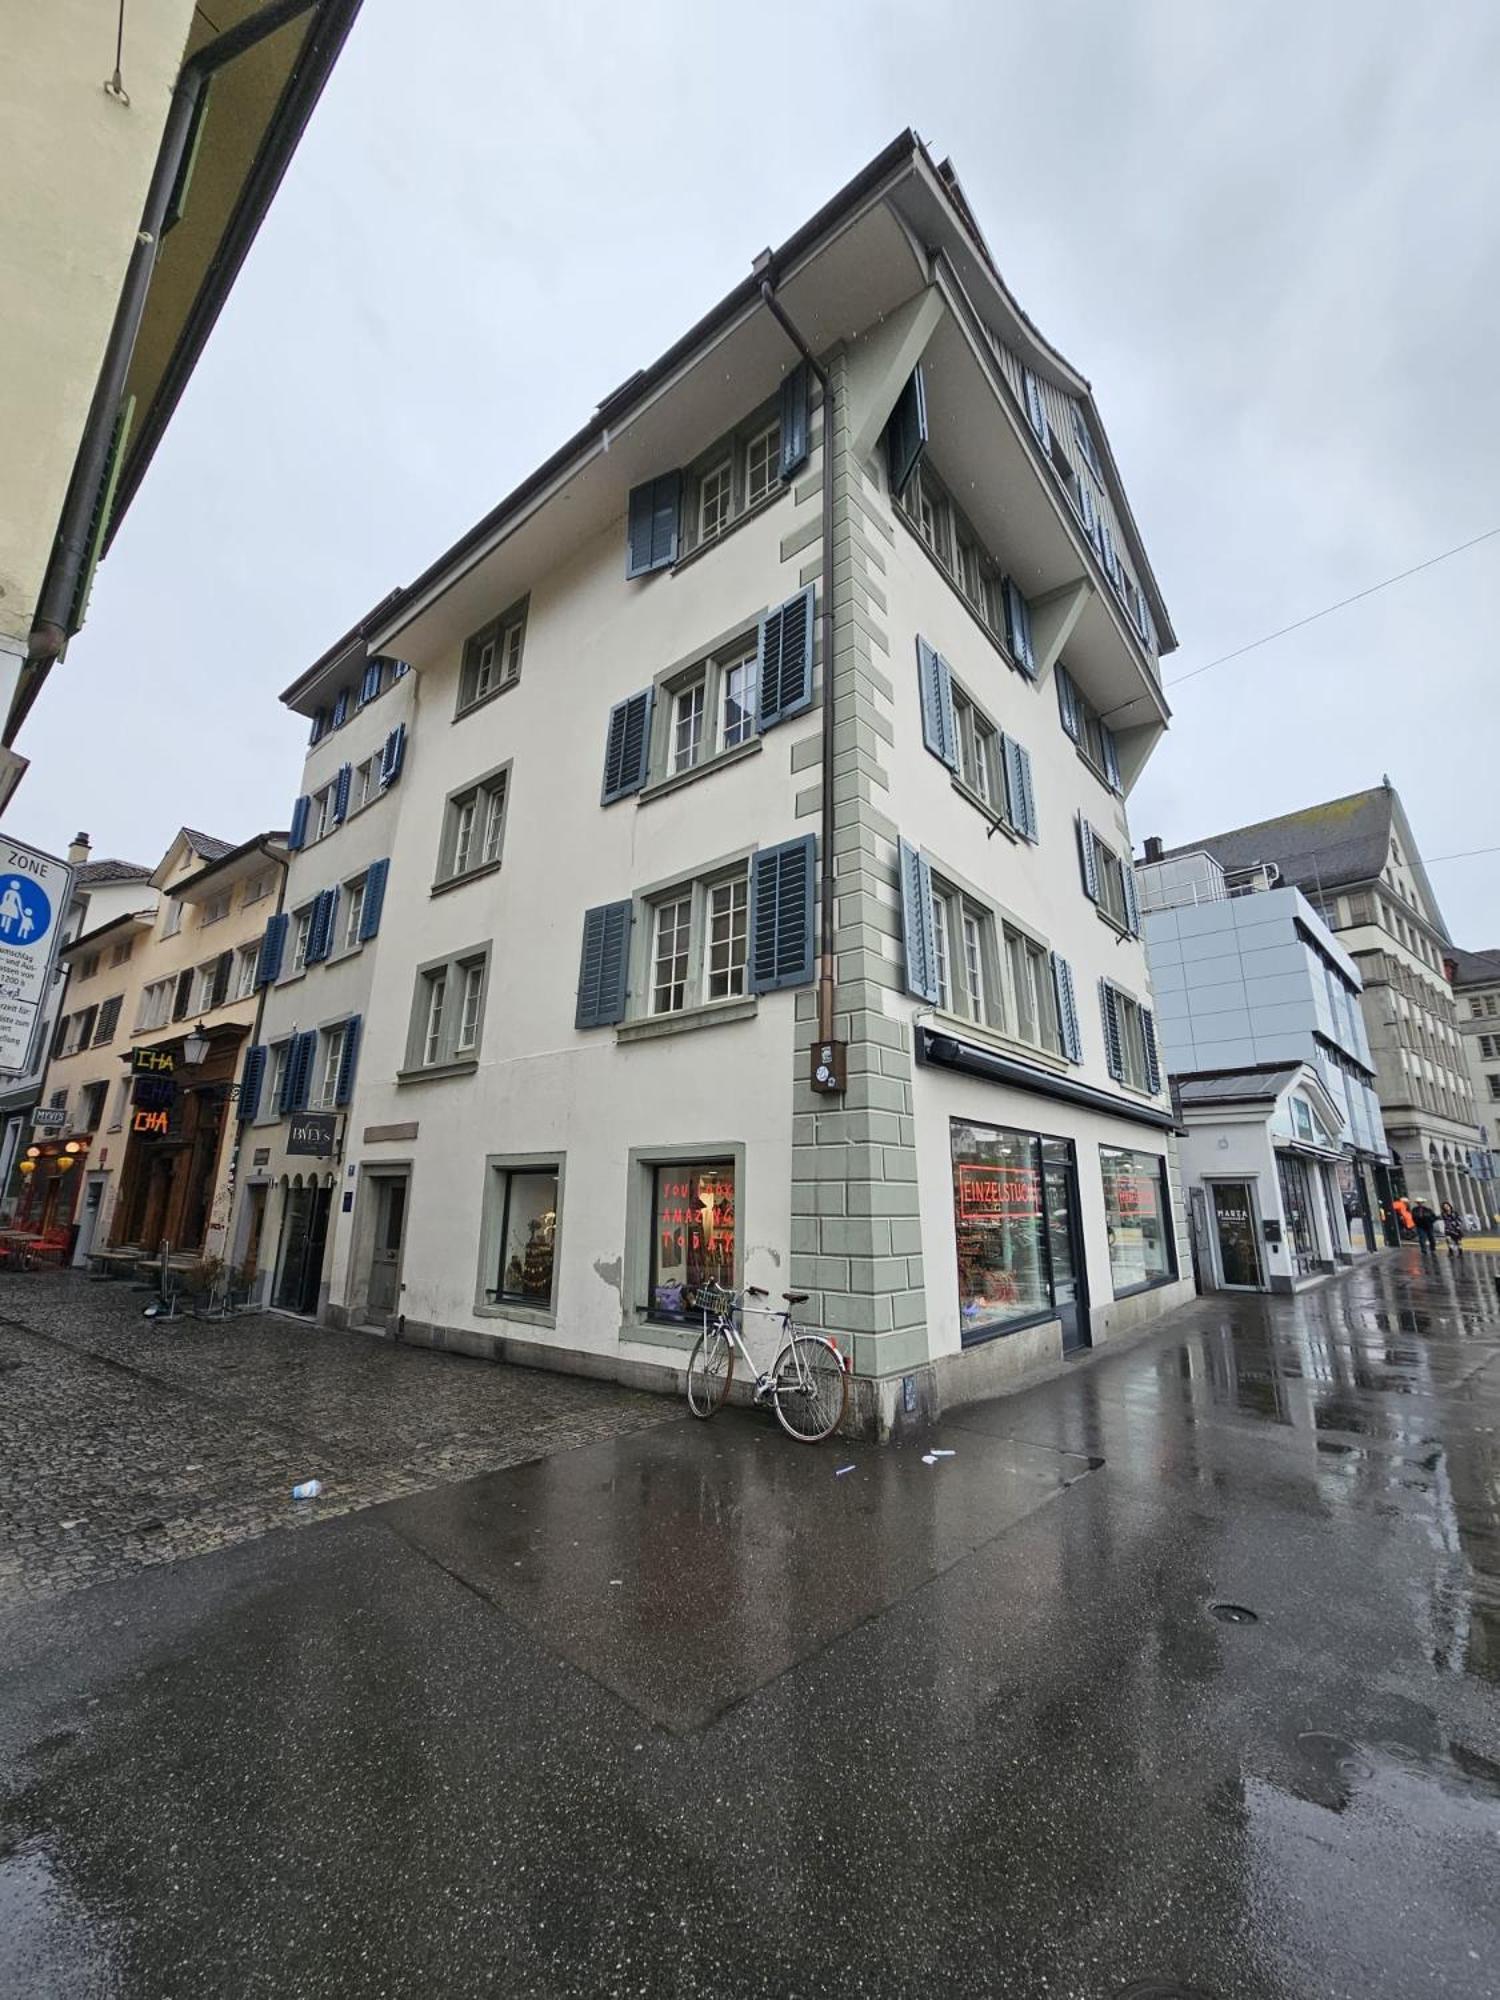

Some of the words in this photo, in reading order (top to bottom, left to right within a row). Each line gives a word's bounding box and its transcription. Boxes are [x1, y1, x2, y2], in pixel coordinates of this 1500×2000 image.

[8, 851, 49, 878] ZONE
[137, 1051, 174, 1071] CHA
[134, 1110, 168, 1134] CHA
[663, 1184, 689, 1200] YOU
[661, 1205, 734, 1225] AMAZNG
[661, 1229, 734, 1254] TODAY
